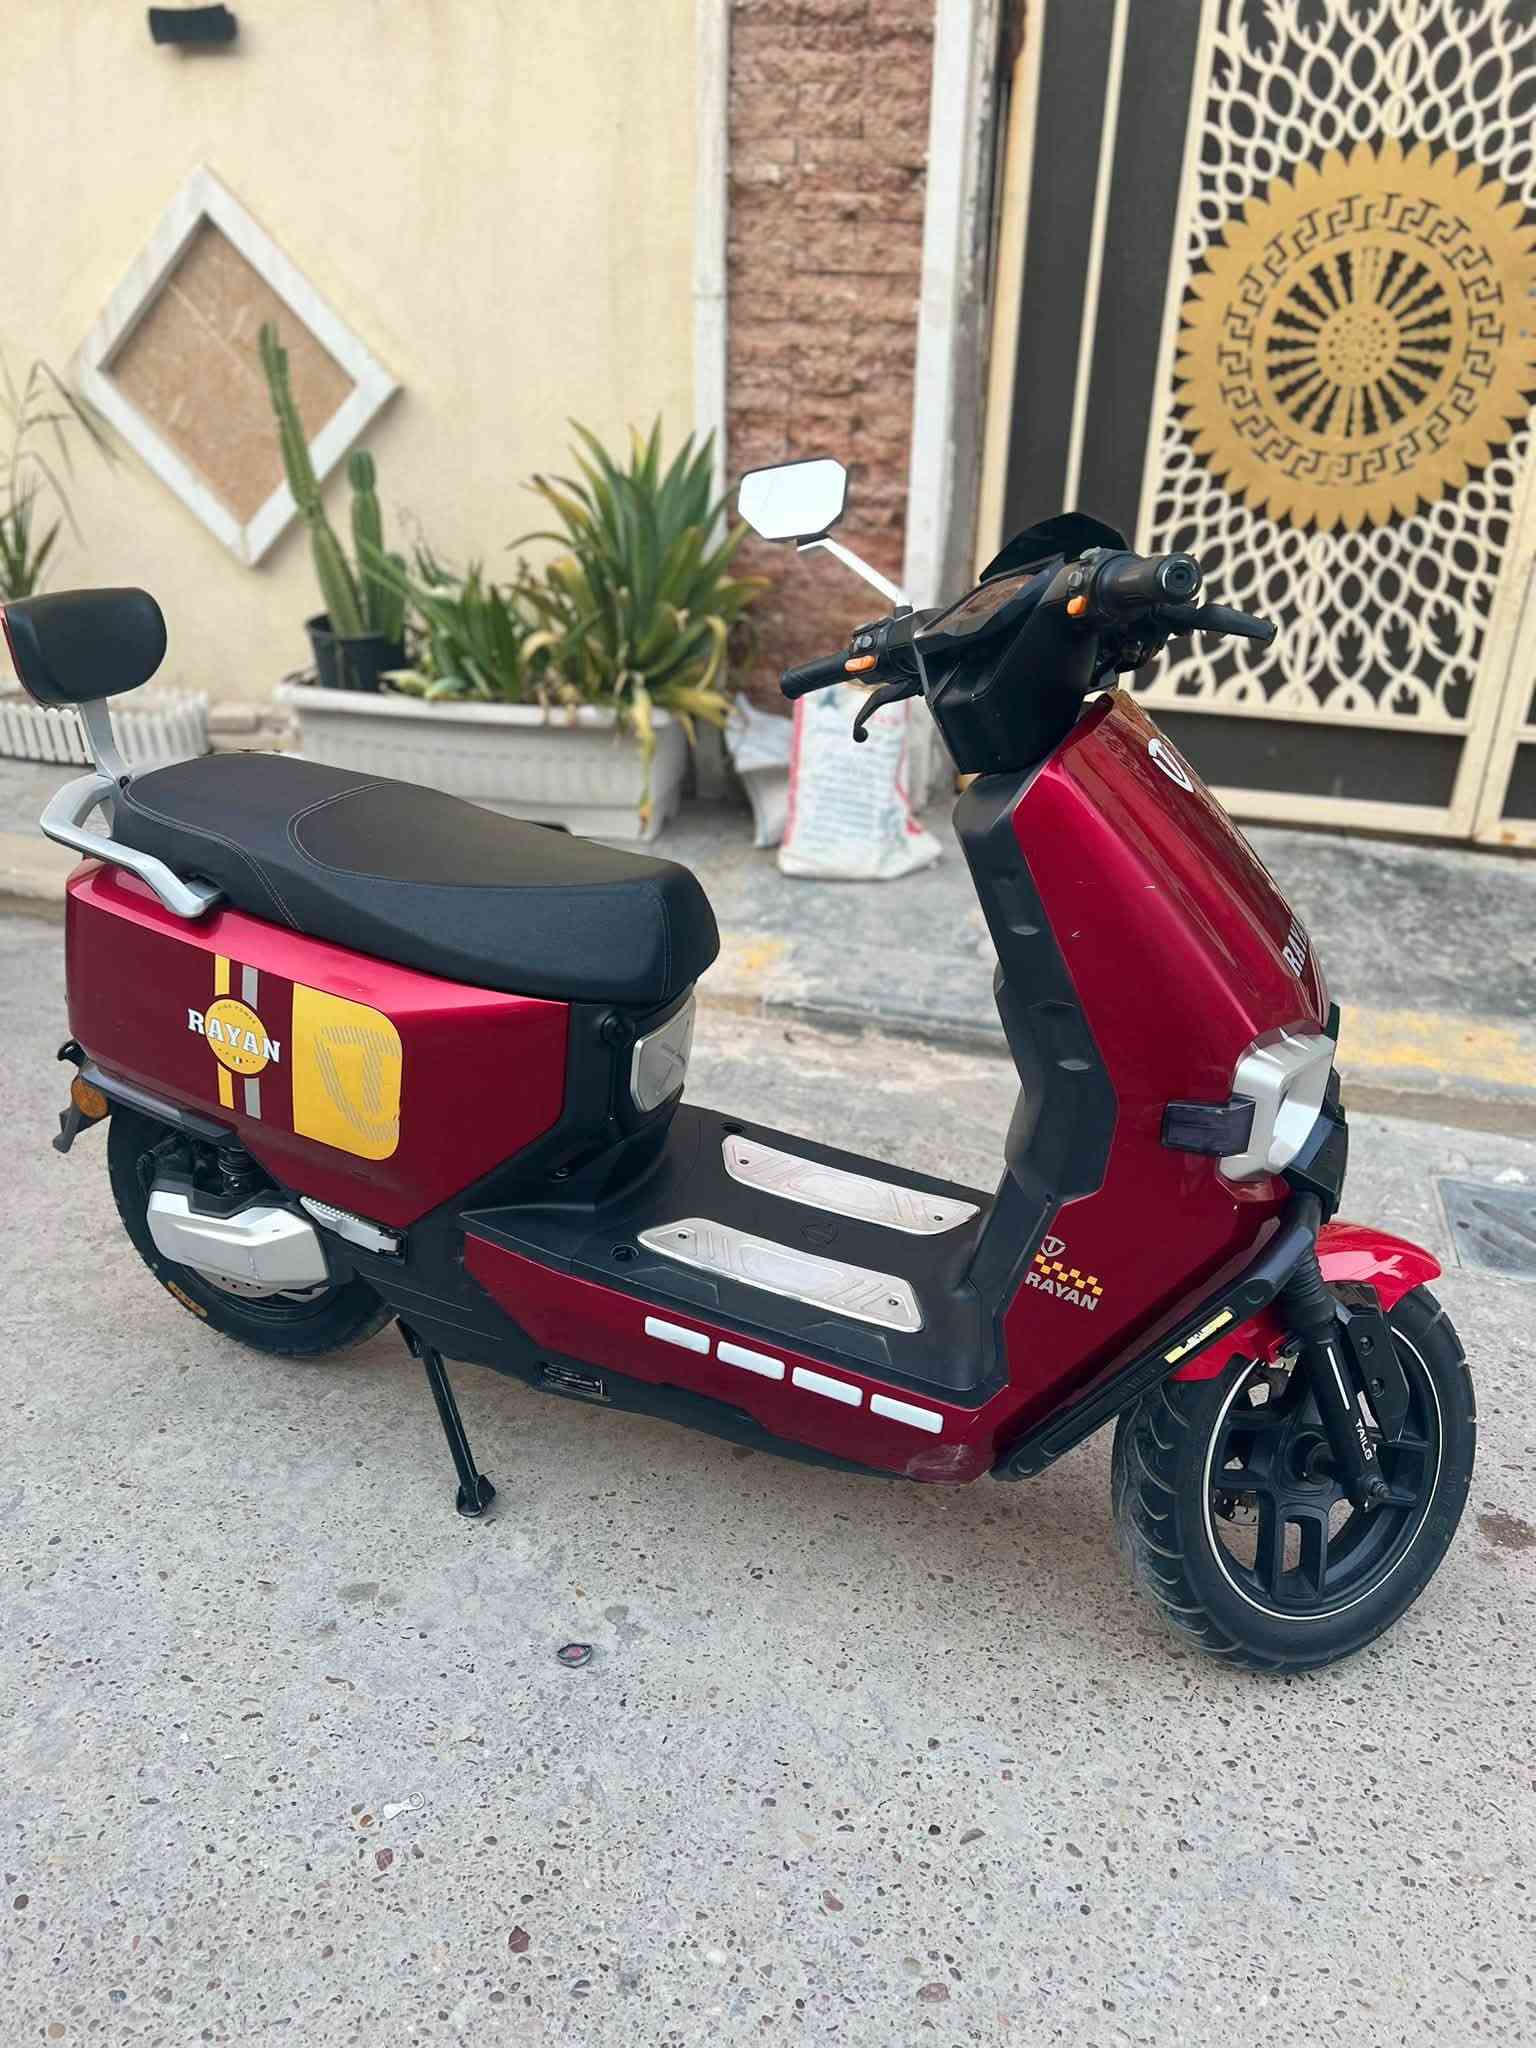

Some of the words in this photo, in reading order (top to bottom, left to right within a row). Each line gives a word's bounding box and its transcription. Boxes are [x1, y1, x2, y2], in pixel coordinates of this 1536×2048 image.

[187, 1008, 281, 1063] RAYAN
[1024, 1271, 1099, 1311] RAYAN
[1355, 1418, 1374, 1461] TAILG
